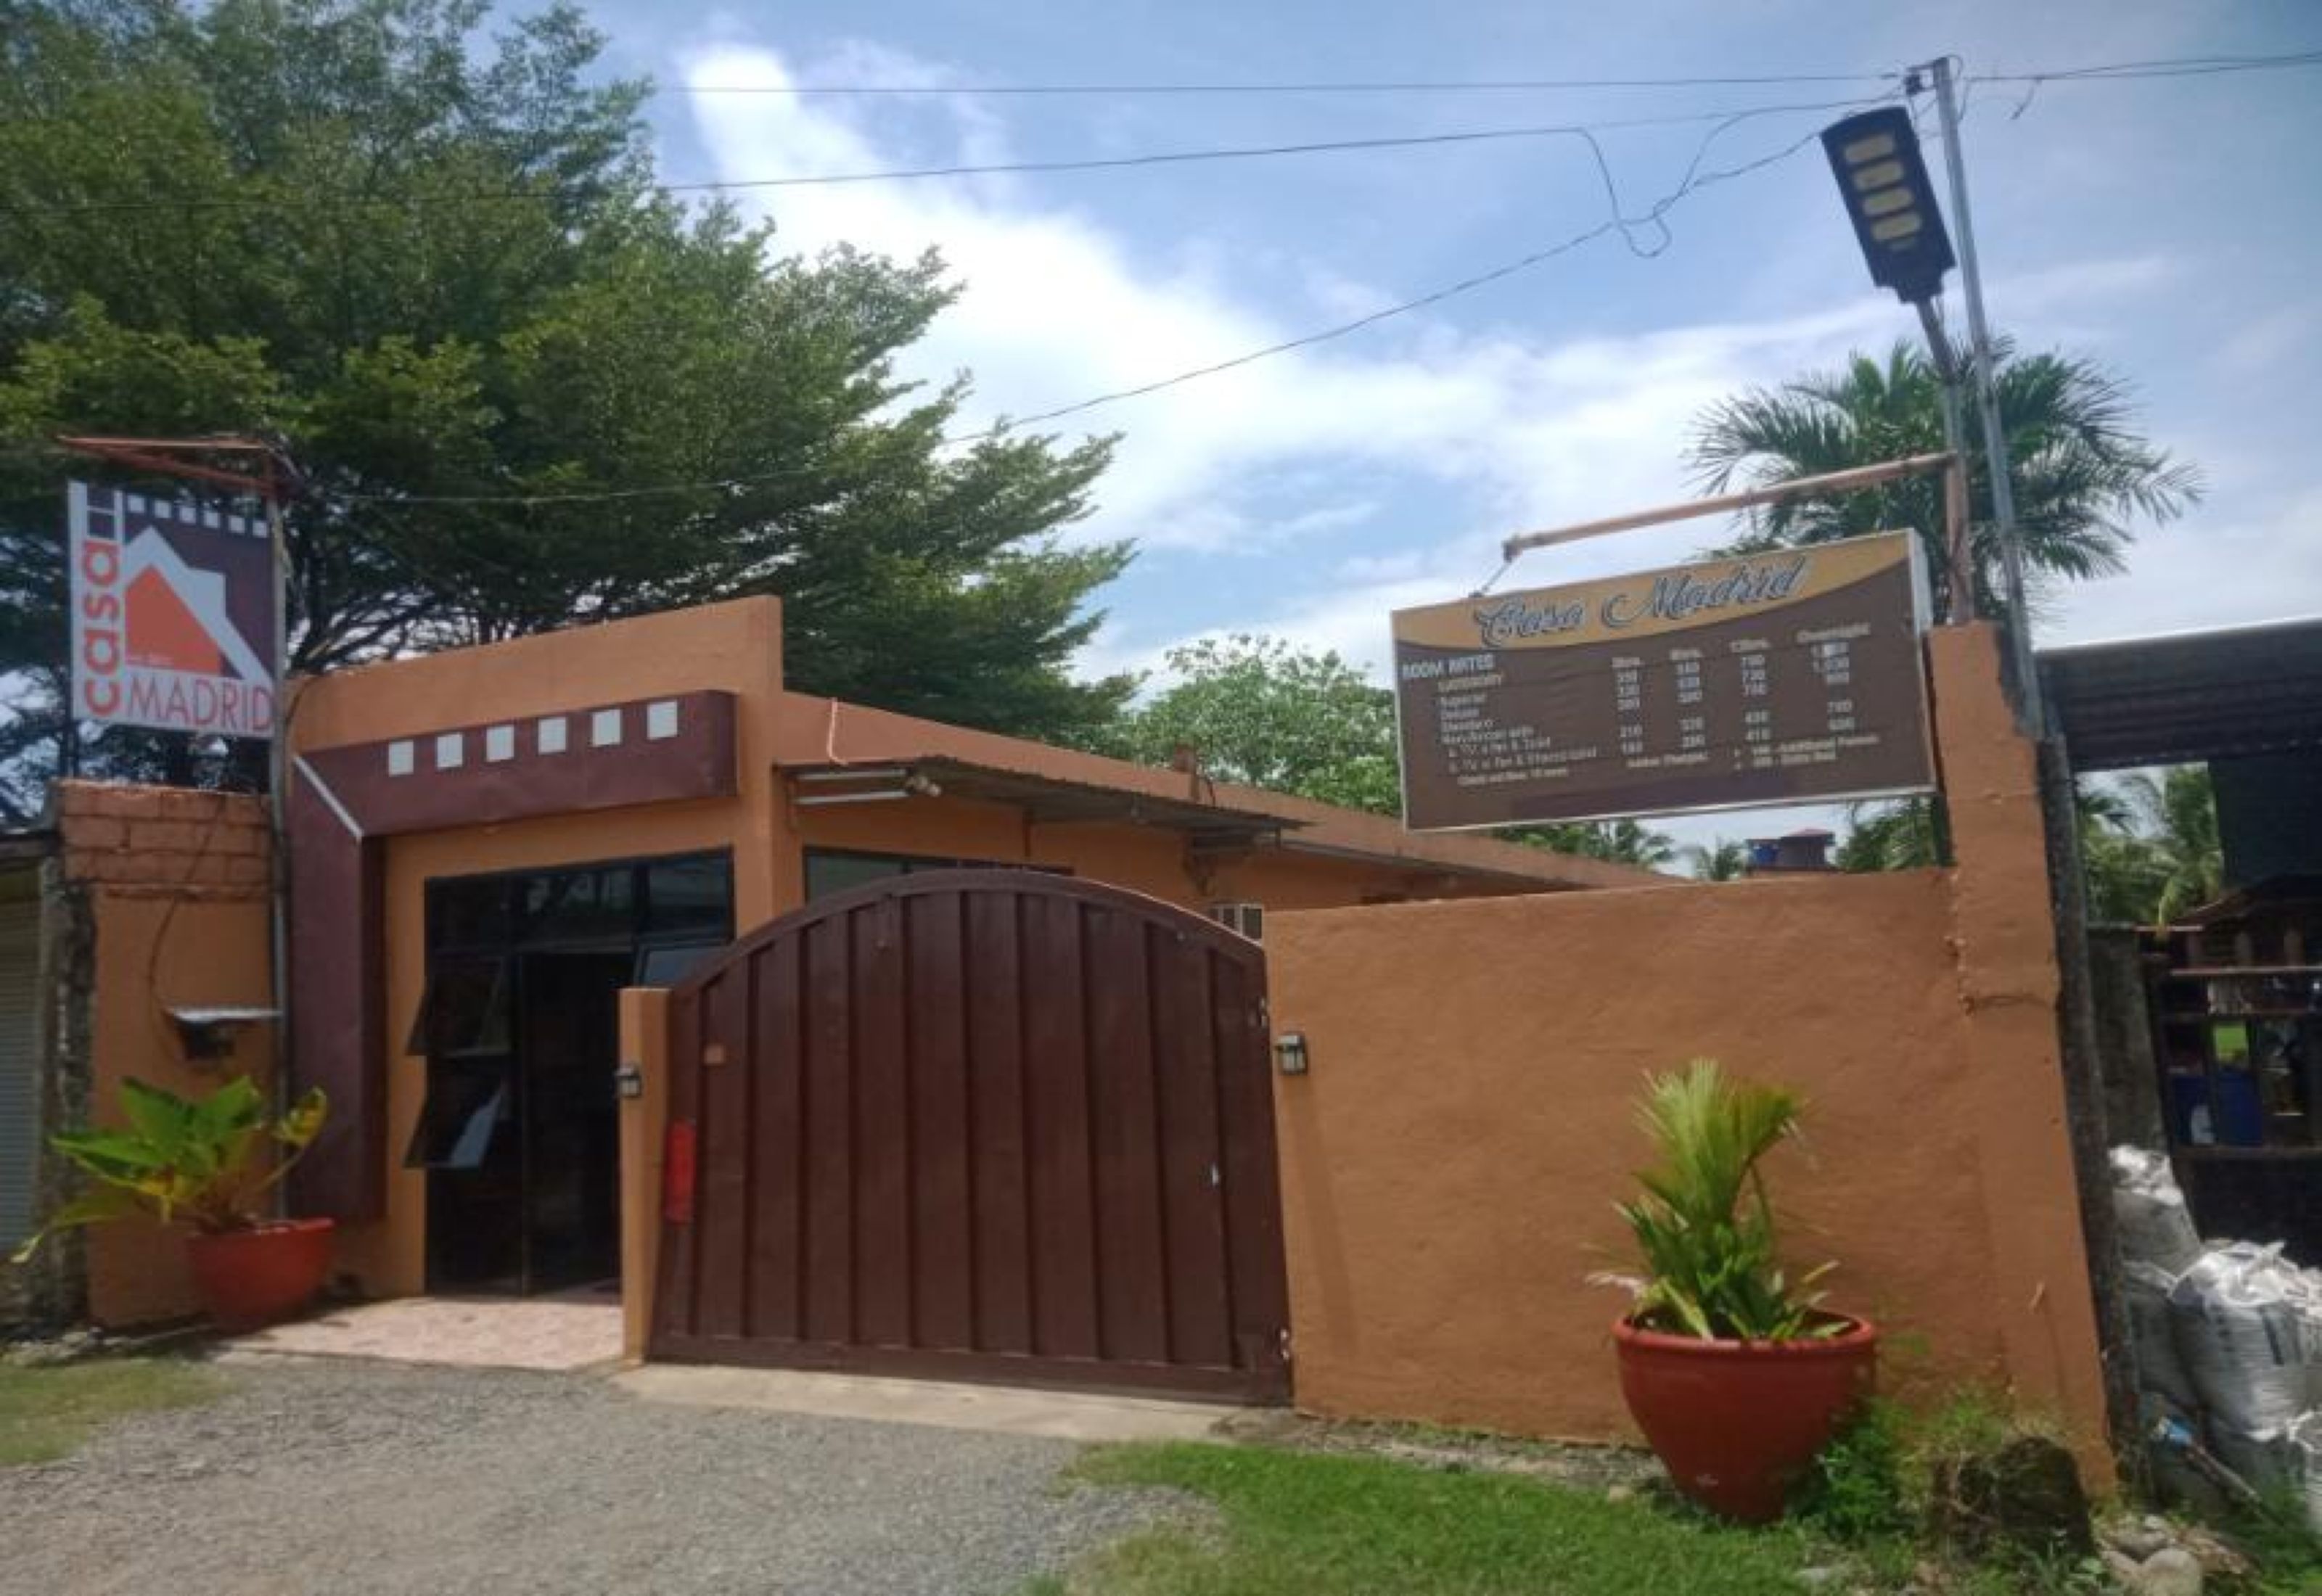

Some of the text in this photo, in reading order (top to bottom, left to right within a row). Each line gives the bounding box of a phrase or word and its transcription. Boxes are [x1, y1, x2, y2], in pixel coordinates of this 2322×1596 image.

[83, 540, 121, 717] casa
[1473, 555, 1807, 648] Casa Madrid
[127, 675, 274, 731] MADRID
